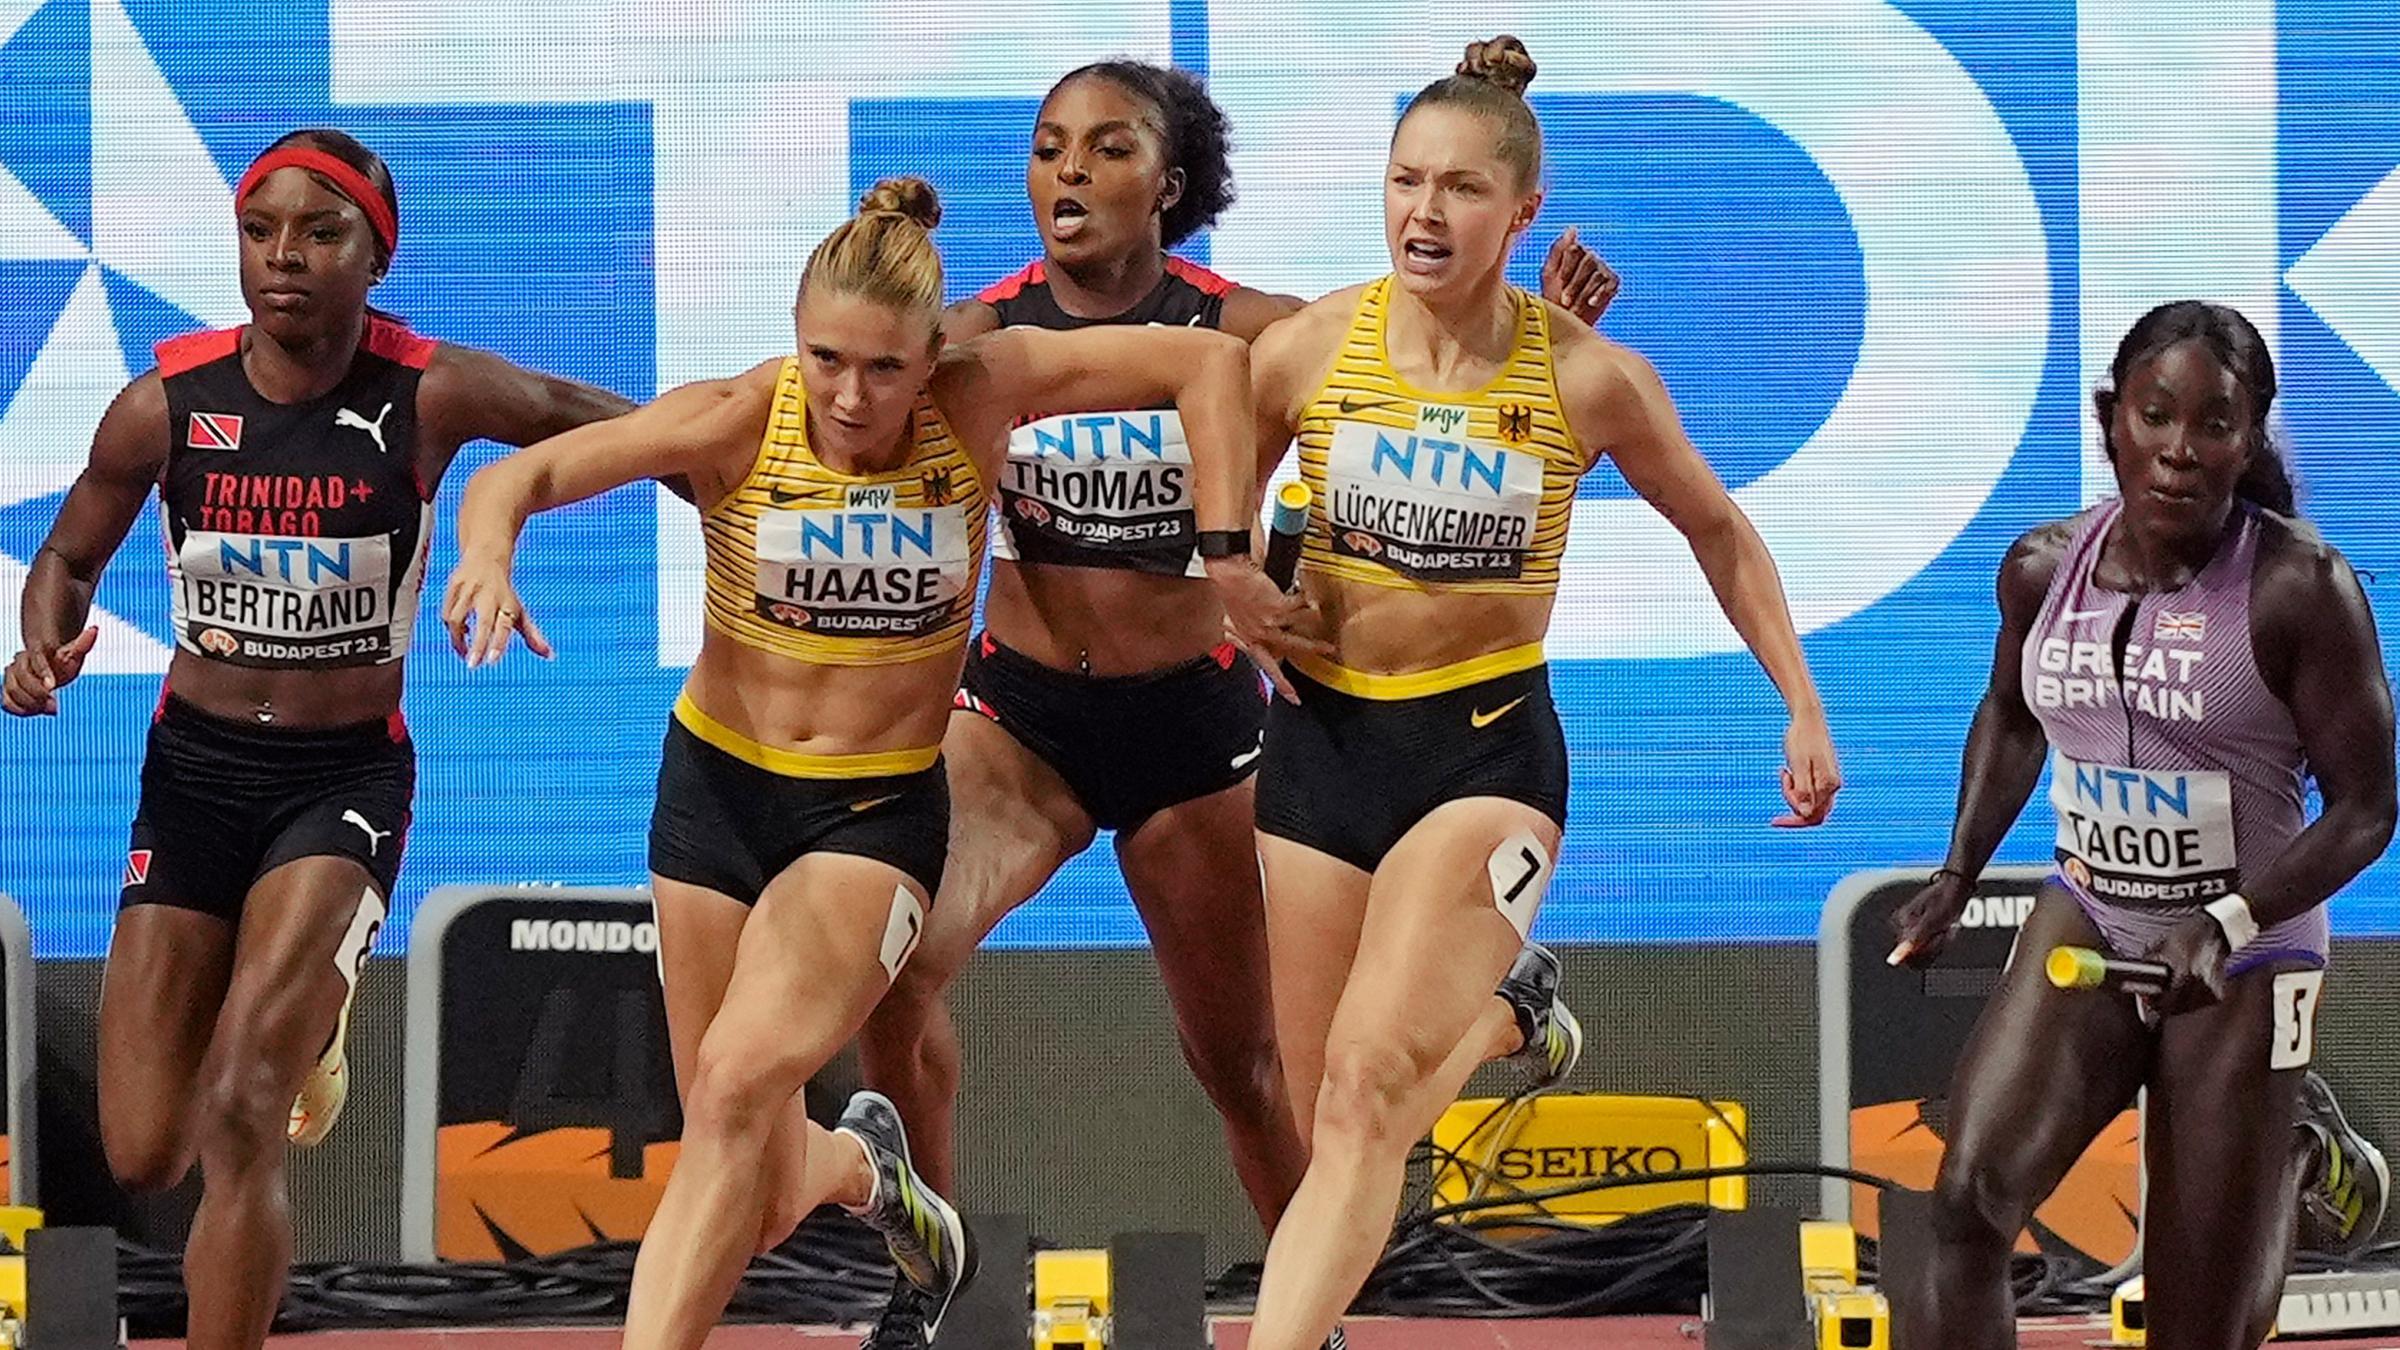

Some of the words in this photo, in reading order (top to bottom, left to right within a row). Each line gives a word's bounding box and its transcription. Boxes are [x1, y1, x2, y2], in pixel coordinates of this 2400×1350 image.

[1034, 415, 1163, 461] NTN
[1007, 460, 1184, 510] THOMAS
[1371, 431, 1506, 495] NTN
[200, 505, 320, 537] TOBAGO
[802, 513, 933, 560] NTN
[1055, 516, 1157, 541] BUDAPEST
[1158, 520, 1181, 537] 23
[1334, 484, 1526, 547] LÜCKENKEMPER
[220, 538, 350, 585] NTN
[1386, 545, 1488, 569] BUDAPEST
[1488, 552, 1511, 568] 23
[196, 579, 376, 633] BERTRAND
[785, 567, 940, 604] HAASE
[243, 641, 355, 661] BUDAPEST
[355, 637, 379, 652] 23
[2039, 637, 2204, 684] GREAT
[2035, 674, 2202, 722] BRITAIN
[2074, 764, 2188, 819] NTN
[2068, 811, 2202, 870] TAGOE
[1504, 846, 1541, 904] 7
[2093, 877, 2200, 901] BUDAPEST
[2201, 878, 2226, 895] 23
[511, 919, 658, 952] MONDO
[894, 911, 918, 970] 7
[1499, 1147, 1682, 1181] SEIKO
